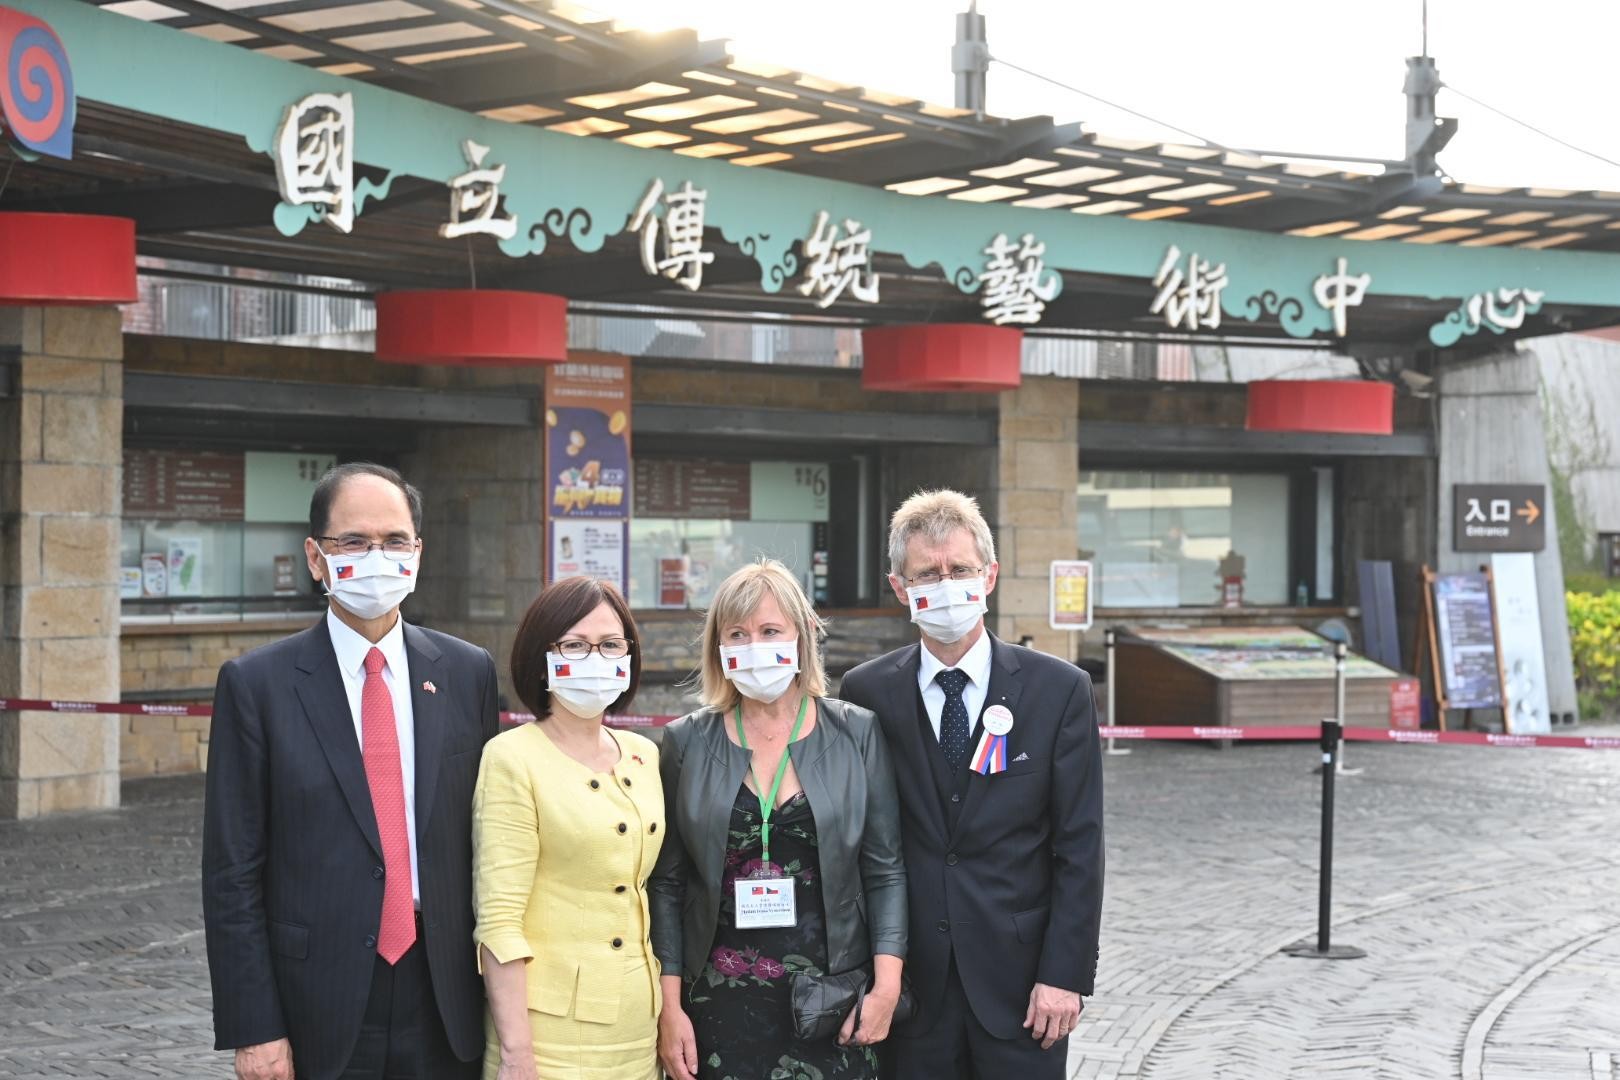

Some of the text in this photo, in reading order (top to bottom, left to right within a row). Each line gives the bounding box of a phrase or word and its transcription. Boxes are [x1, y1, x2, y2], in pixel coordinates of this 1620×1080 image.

[273, 91, 1545, 337] 國立傳統藝術中心
[812, 467, 826, 497] 6
[1464, 498, 1511, 522] 入口
[1466, 525, 1510, 537] Entrance
